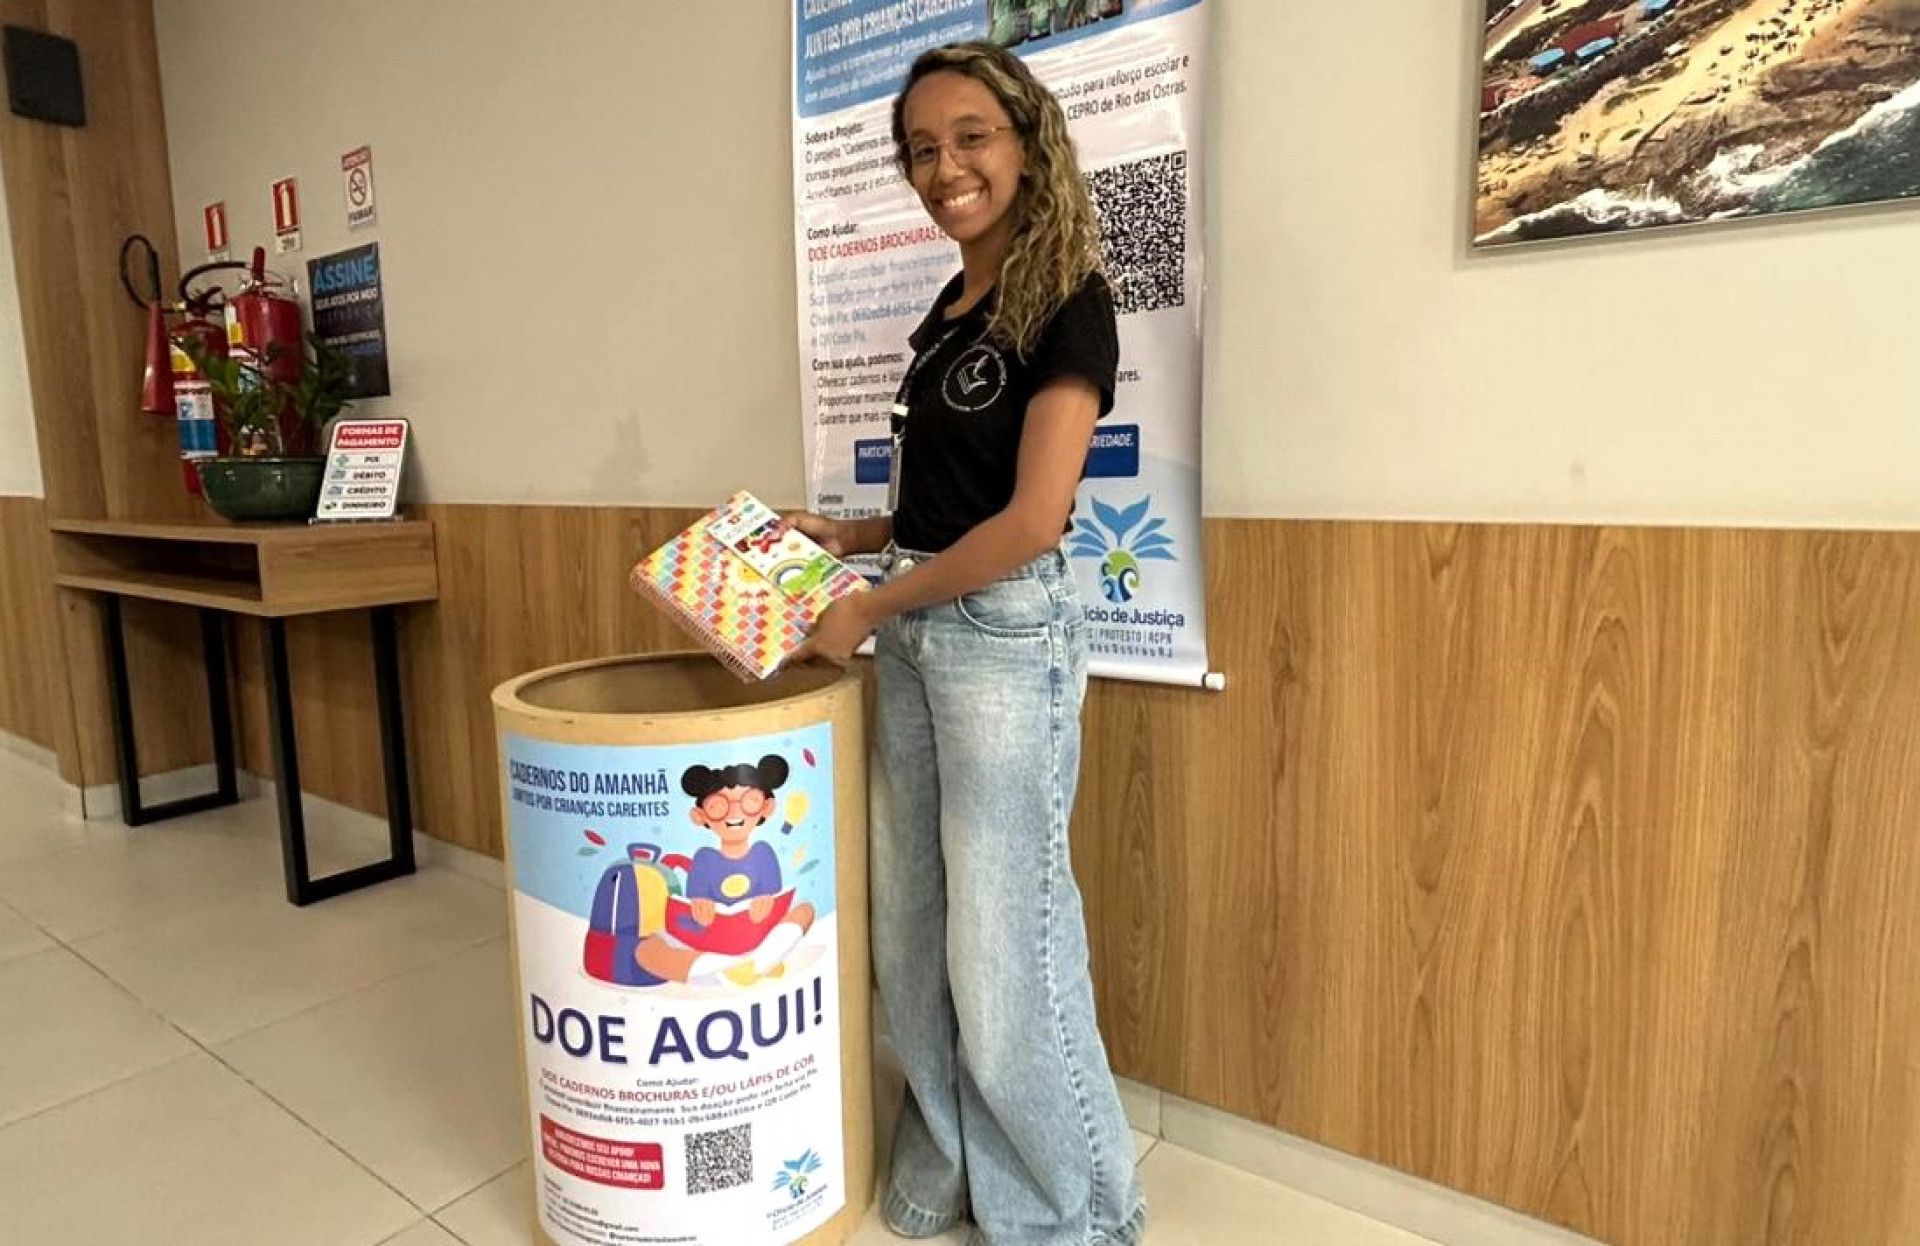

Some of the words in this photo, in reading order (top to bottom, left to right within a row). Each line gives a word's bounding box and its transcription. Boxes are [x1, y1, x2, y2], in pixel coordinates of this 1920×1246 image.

[862, 2, 915, 41] CRIANÇAS
[1083, 78, 1104, 96] para
[1106, 69, 1141, 87] reforço
[1144, 56, 1180, 78] escolar
[1182, 55, 1189, 68] e
[1067, 99, 1099, 121] CEPRO
[1100, 98, 1113, 112] de
[1115, 93, 1131, 109] Rio
[1133, 87, 1151, 104] das
[805, 131, 828, 145] Sobre
[806, 150, 812, 164] O
[807, 226, 830, 240] Como
[832, 219, 860, 239] Ajudar:
[808, 245, 827, 262] DOE
[829, 236, 878, 259] CADERNOS
[879, 225, 937, 251] BROCHURAS
[313, 252, 377, 292] ASSINE
[812, 358, 829, 371] Com
[342, 426, 383, 435] FORMAS
[385, 425, 400, 435] DE
[337, 437, 400, 447] PAGAMENTO
[353, 470, 386, 480] DÉBITO
[346, 485, 387, 494] CRÉDITO
[341, 502, 386, 510] DINHEIRO
[1111, 607, 1128, 624] de
[1129, 608, 1184, 631] Justiça
[511, 759, 566, 792] CADERNOS
[569, 771, 589, 794] DO
[594, 768, 669, 796] AMANHÃ
[536, 792, 551, 811] POR
[554, 797, 605, 818] CRIANÇAS
[606, 800, 669, 818] CARENTES
[530, 993, 628, 1065] DOE
[647, 976, 824, 1066] AQUI!
[559, 1077, 616, 1100] CADERNOS
[619, 1087, 699, 1102] BROCHURAS
[701, 1081, 737, 1099] E/OU
[740, 1071, 775, 1091] LÁPIS
[776, 1064, 793, 1079] DE
[793, 1053, 816, 1072] COR
[636, 1078, 663, 1087] Como
